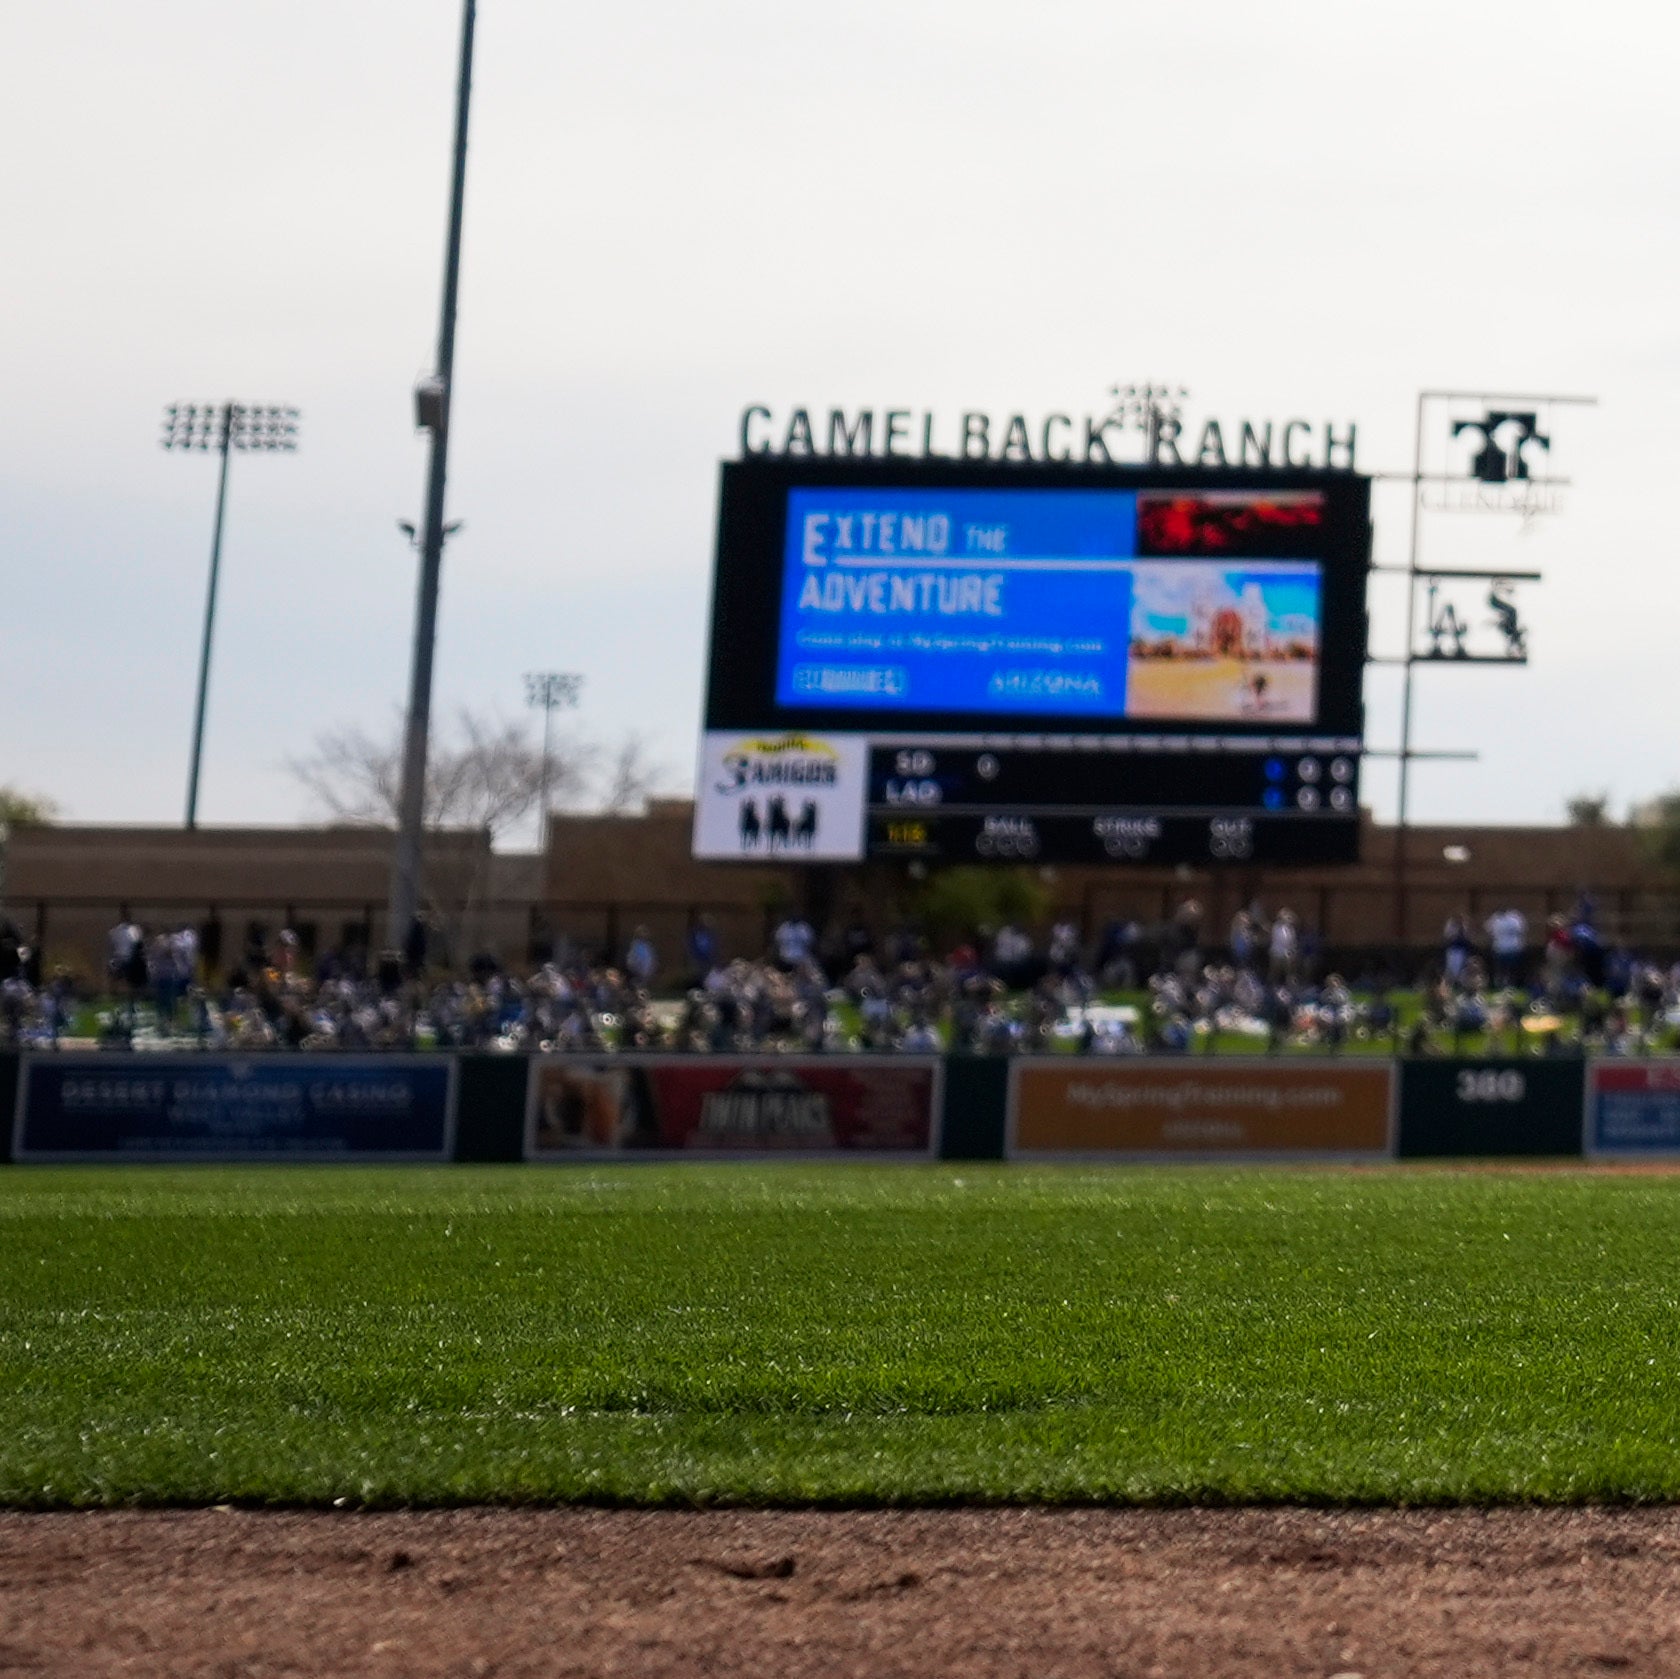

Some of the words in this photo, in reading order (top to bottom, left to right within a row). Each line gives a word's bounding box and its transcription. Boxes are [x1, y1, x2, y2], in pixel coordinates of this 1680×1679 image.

[740, 405, 1117, 462] CAMELBACK
[1156, 413, 1358, 472] RANCH
[803, 514, 950, 567] EXTEND
[966, 524, 1007, 553] THE
[799, 573, 1004, 616] ADVENTURE
[61, 1082, 164, 1100] DESERT
[173, 1082, 300, 1100] DIAMOND
[308, 1082, 412, 1102] CASINO
